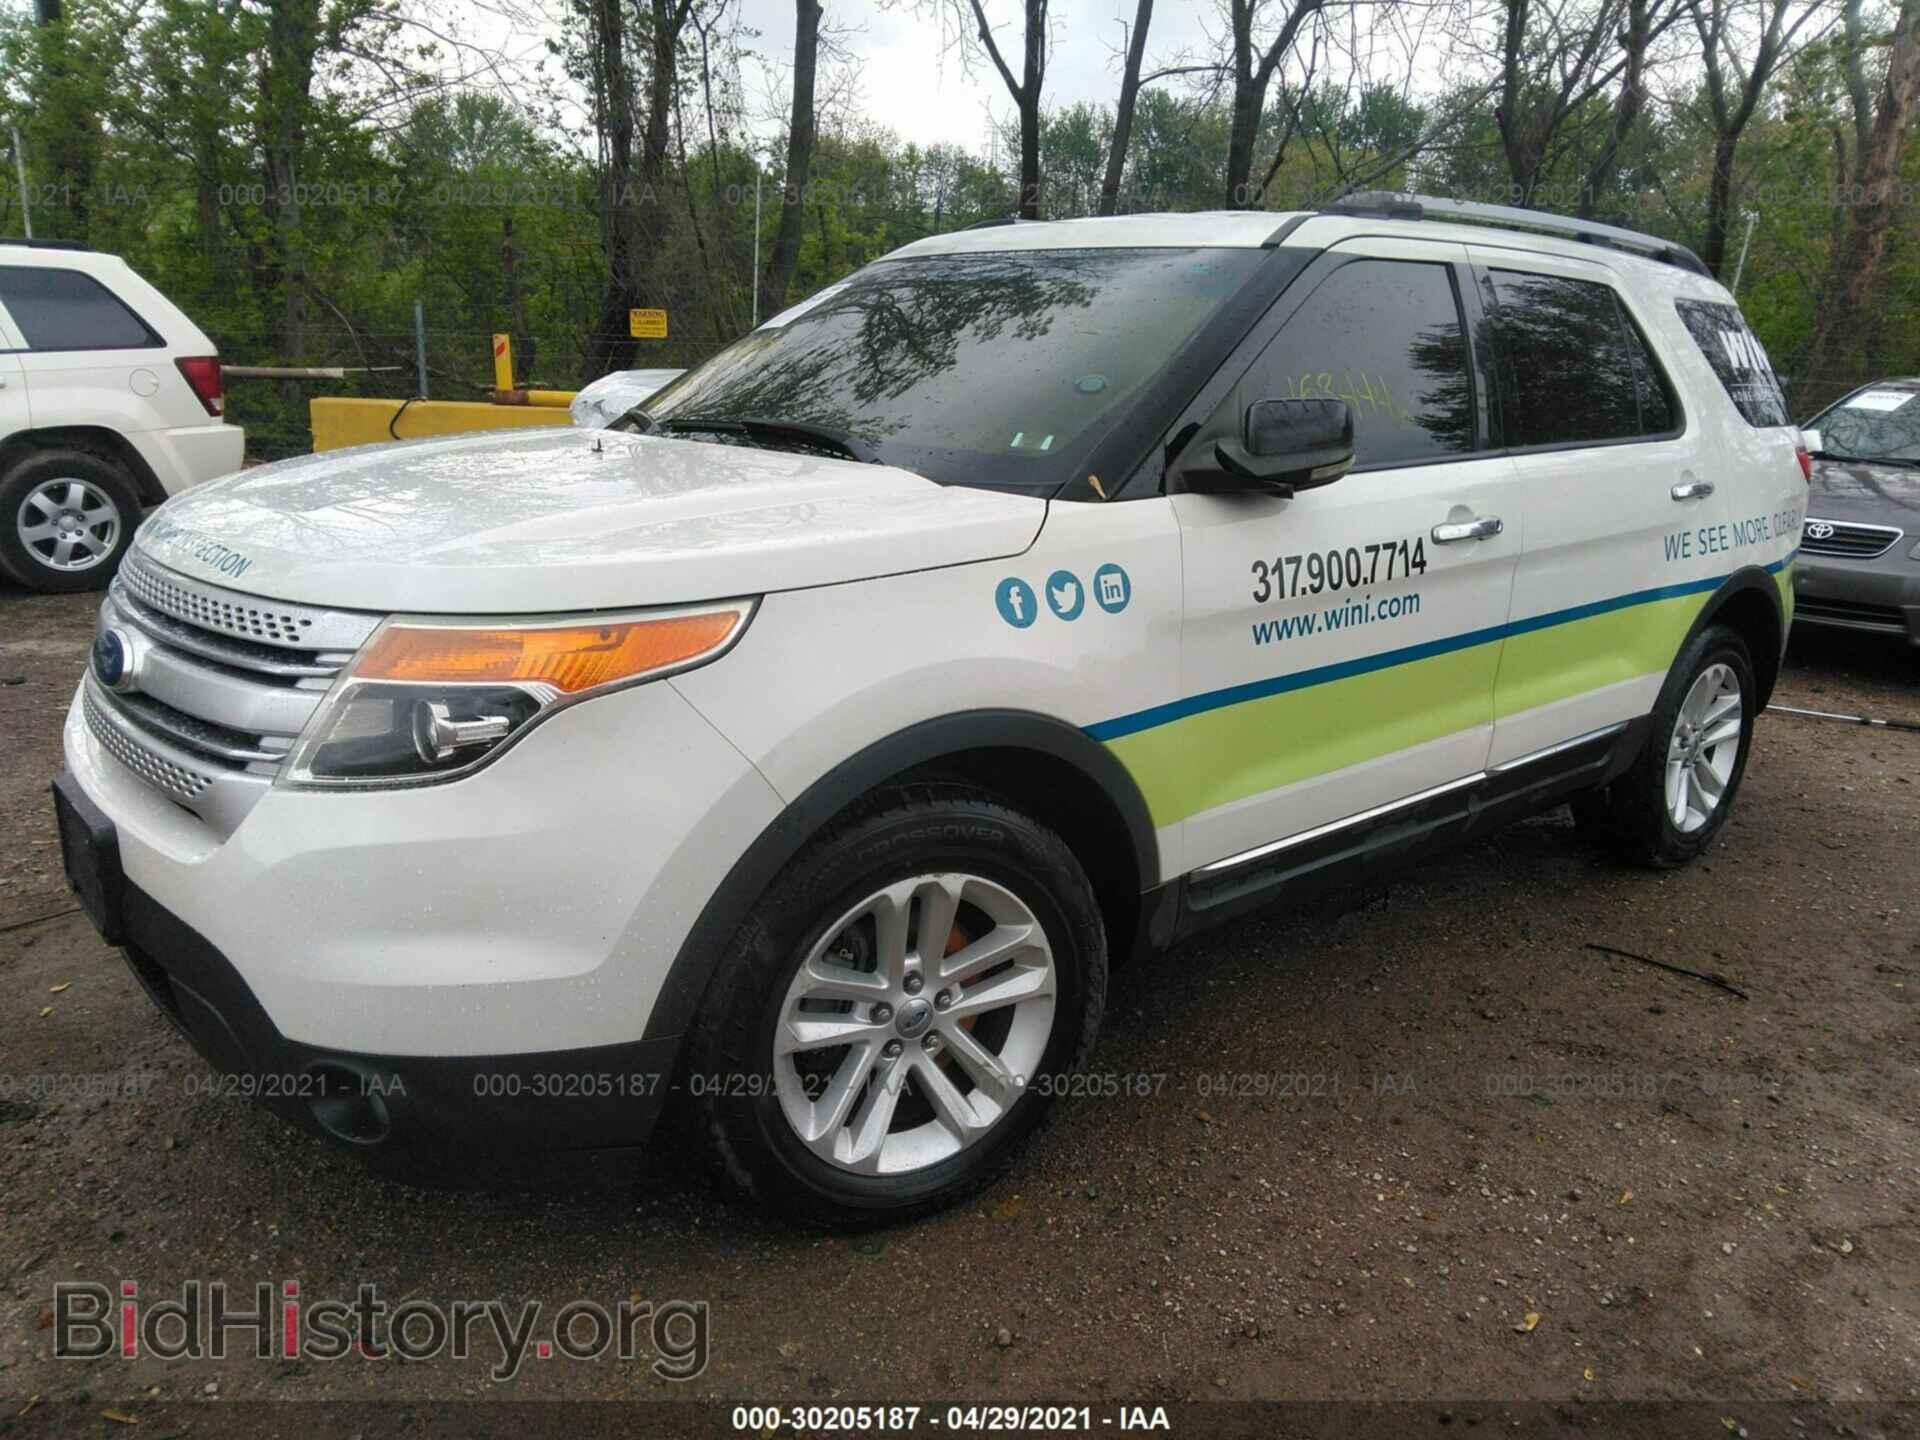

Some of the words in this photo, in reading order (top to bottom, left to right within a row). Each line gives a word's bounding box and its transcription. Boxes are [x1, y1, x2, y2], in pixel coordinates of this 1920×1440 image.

[1251, 536, 1427, 603] 317.900.7714
[1664, 531, 1692, 562] WE
[1697, 525, 1729, 556] SEE
[1251, 593, 1421, 646] www.wini.com
